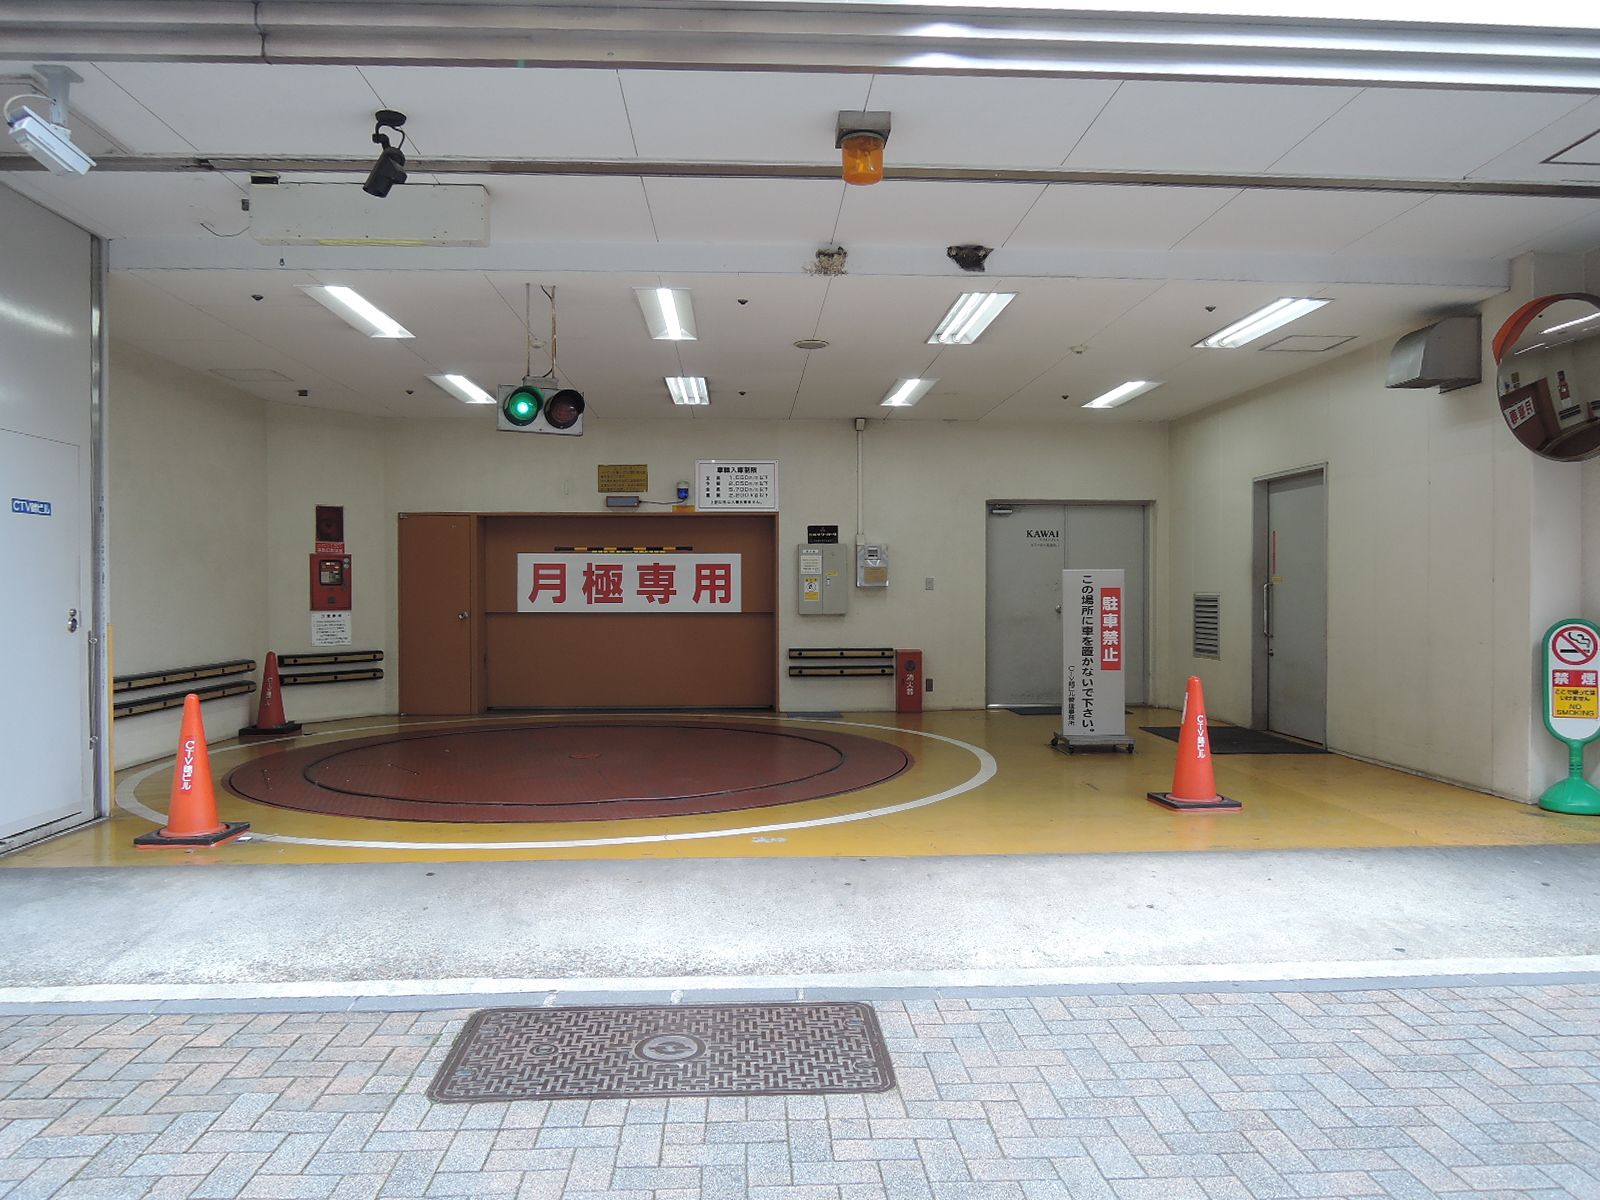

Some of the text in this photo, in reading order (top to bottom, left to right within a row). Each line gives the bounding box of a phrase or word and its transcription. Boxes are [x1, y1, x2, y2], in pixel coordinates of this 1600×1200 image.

[1026, 529, 1059, 538] KAWAI
[528, 562, 732, 604] 月極専用
[1102, 596, 1119, 662] 駐車禁止
[1553, 672, 1597, 686] 禁煙
[1556, 709, 1595, 717] SMOKING
